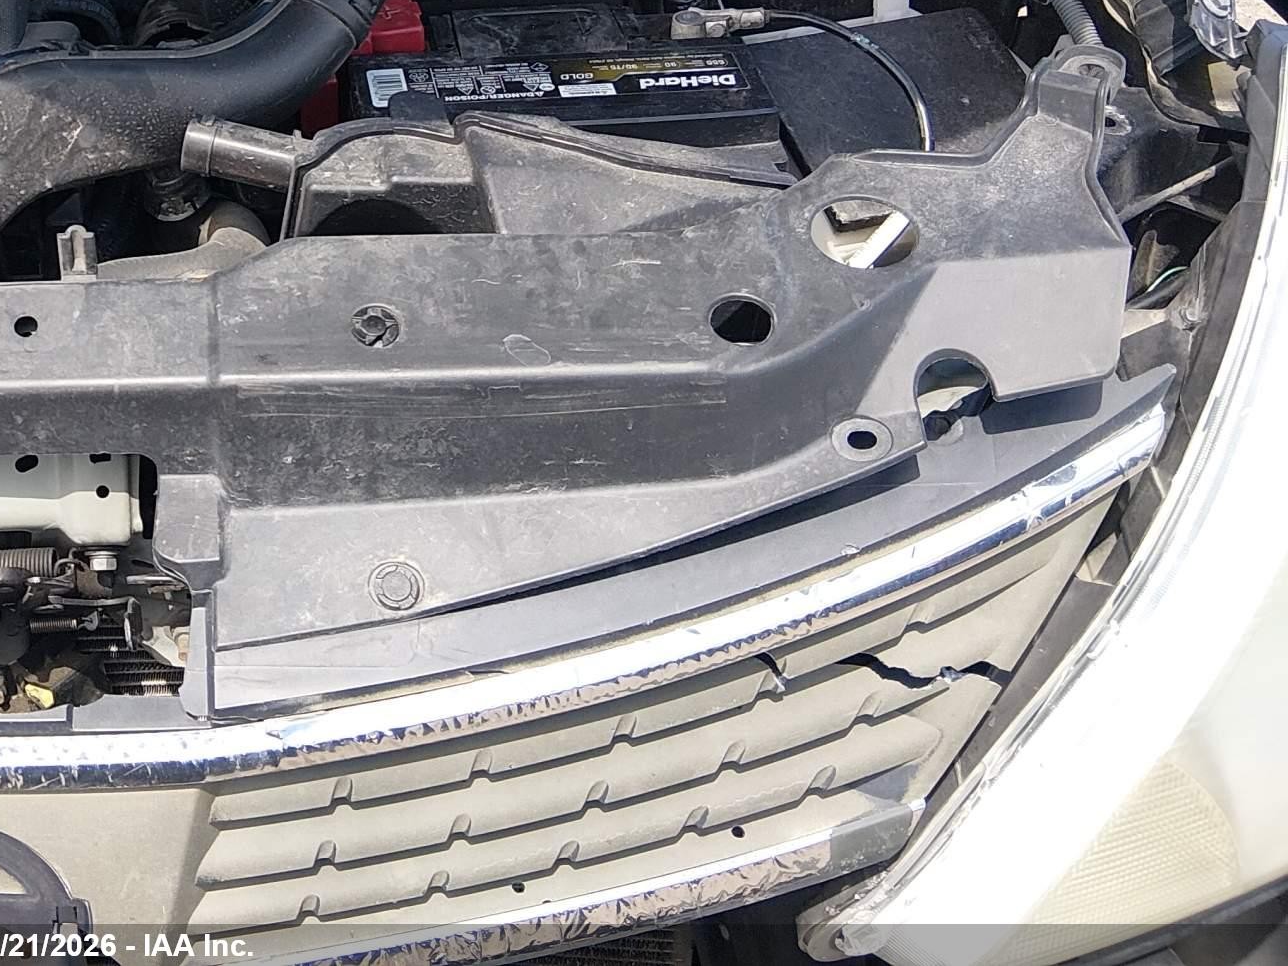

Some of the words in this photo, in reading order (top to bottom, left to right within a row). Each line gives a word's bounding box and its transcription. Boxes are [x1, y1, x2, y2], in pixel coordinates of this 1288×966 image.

[560, 71, 594, 80] GOLD
[639, 73, 736, 90] DieHard
[444, 91, 535, 102] DANGER/POISON
